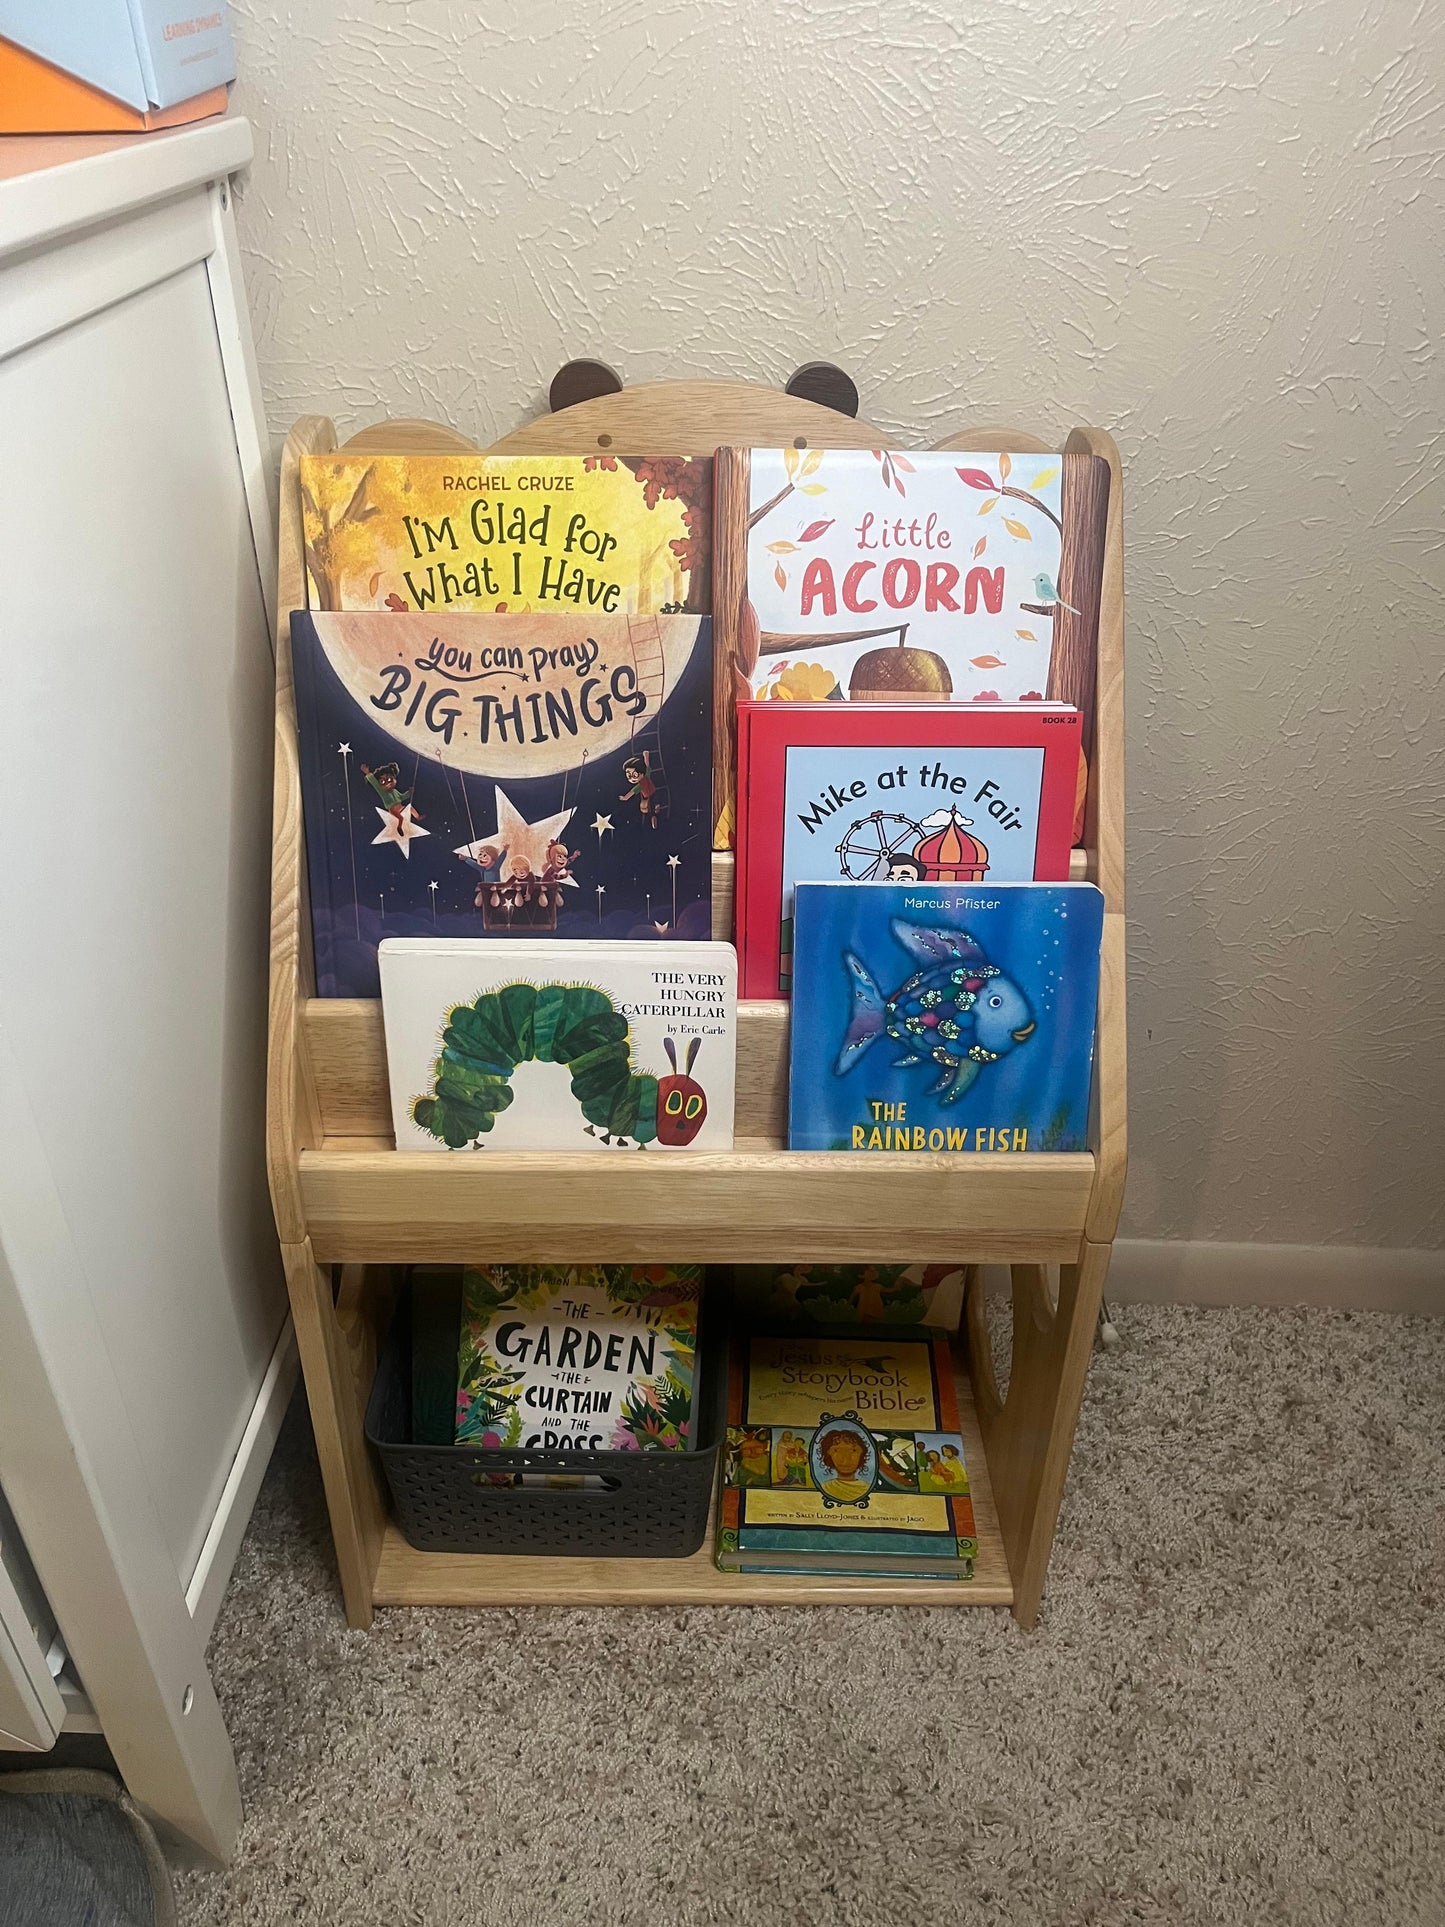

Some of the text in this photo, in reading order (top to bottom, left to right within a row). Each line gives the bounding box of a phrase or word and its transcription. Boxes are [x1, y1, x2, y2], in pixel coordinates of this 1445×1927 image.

[442, 476, 575, 491] RACHEL CRUZE
[470, 498, 551, 547] Glad
[563, 513, 618, 562] for
[855, 511, 952, 550] Little
[403, 552, 621, 613] What I Have
[800, 557, 1005, 616] ACORN
[414, 637, 599, 682] you can pray
[370, 664, 647, 745] BIG THINGS
[797, 762, 1022, 835] Mike at the Fair
[904, 897, 1001, 909] Marcus Pfister
[651, 972, 726, 986] THE VERY
[660, 989, 726, 1002] HUNGRY
[621, 1003, 726, 1018] CATERPILLAR
[667, 1024, 726, 1035] by Eric Carle
[871, 1101, 907, 1122] THE
[851, 1125, 1028, 1151] RAINBOW FISH
[562, 1300, 592, 1319] THE
[495, 1321, 656, 1375] GARDEN
[561, 1371, 581, 1384] THE
[781, 1367, 909, 1393] Storybook
[524, 1385, 613, 1414] CURTAIN
[855, 1389, 926, 1412] Bible
[541, 1416, 591, 1432] AND THE
